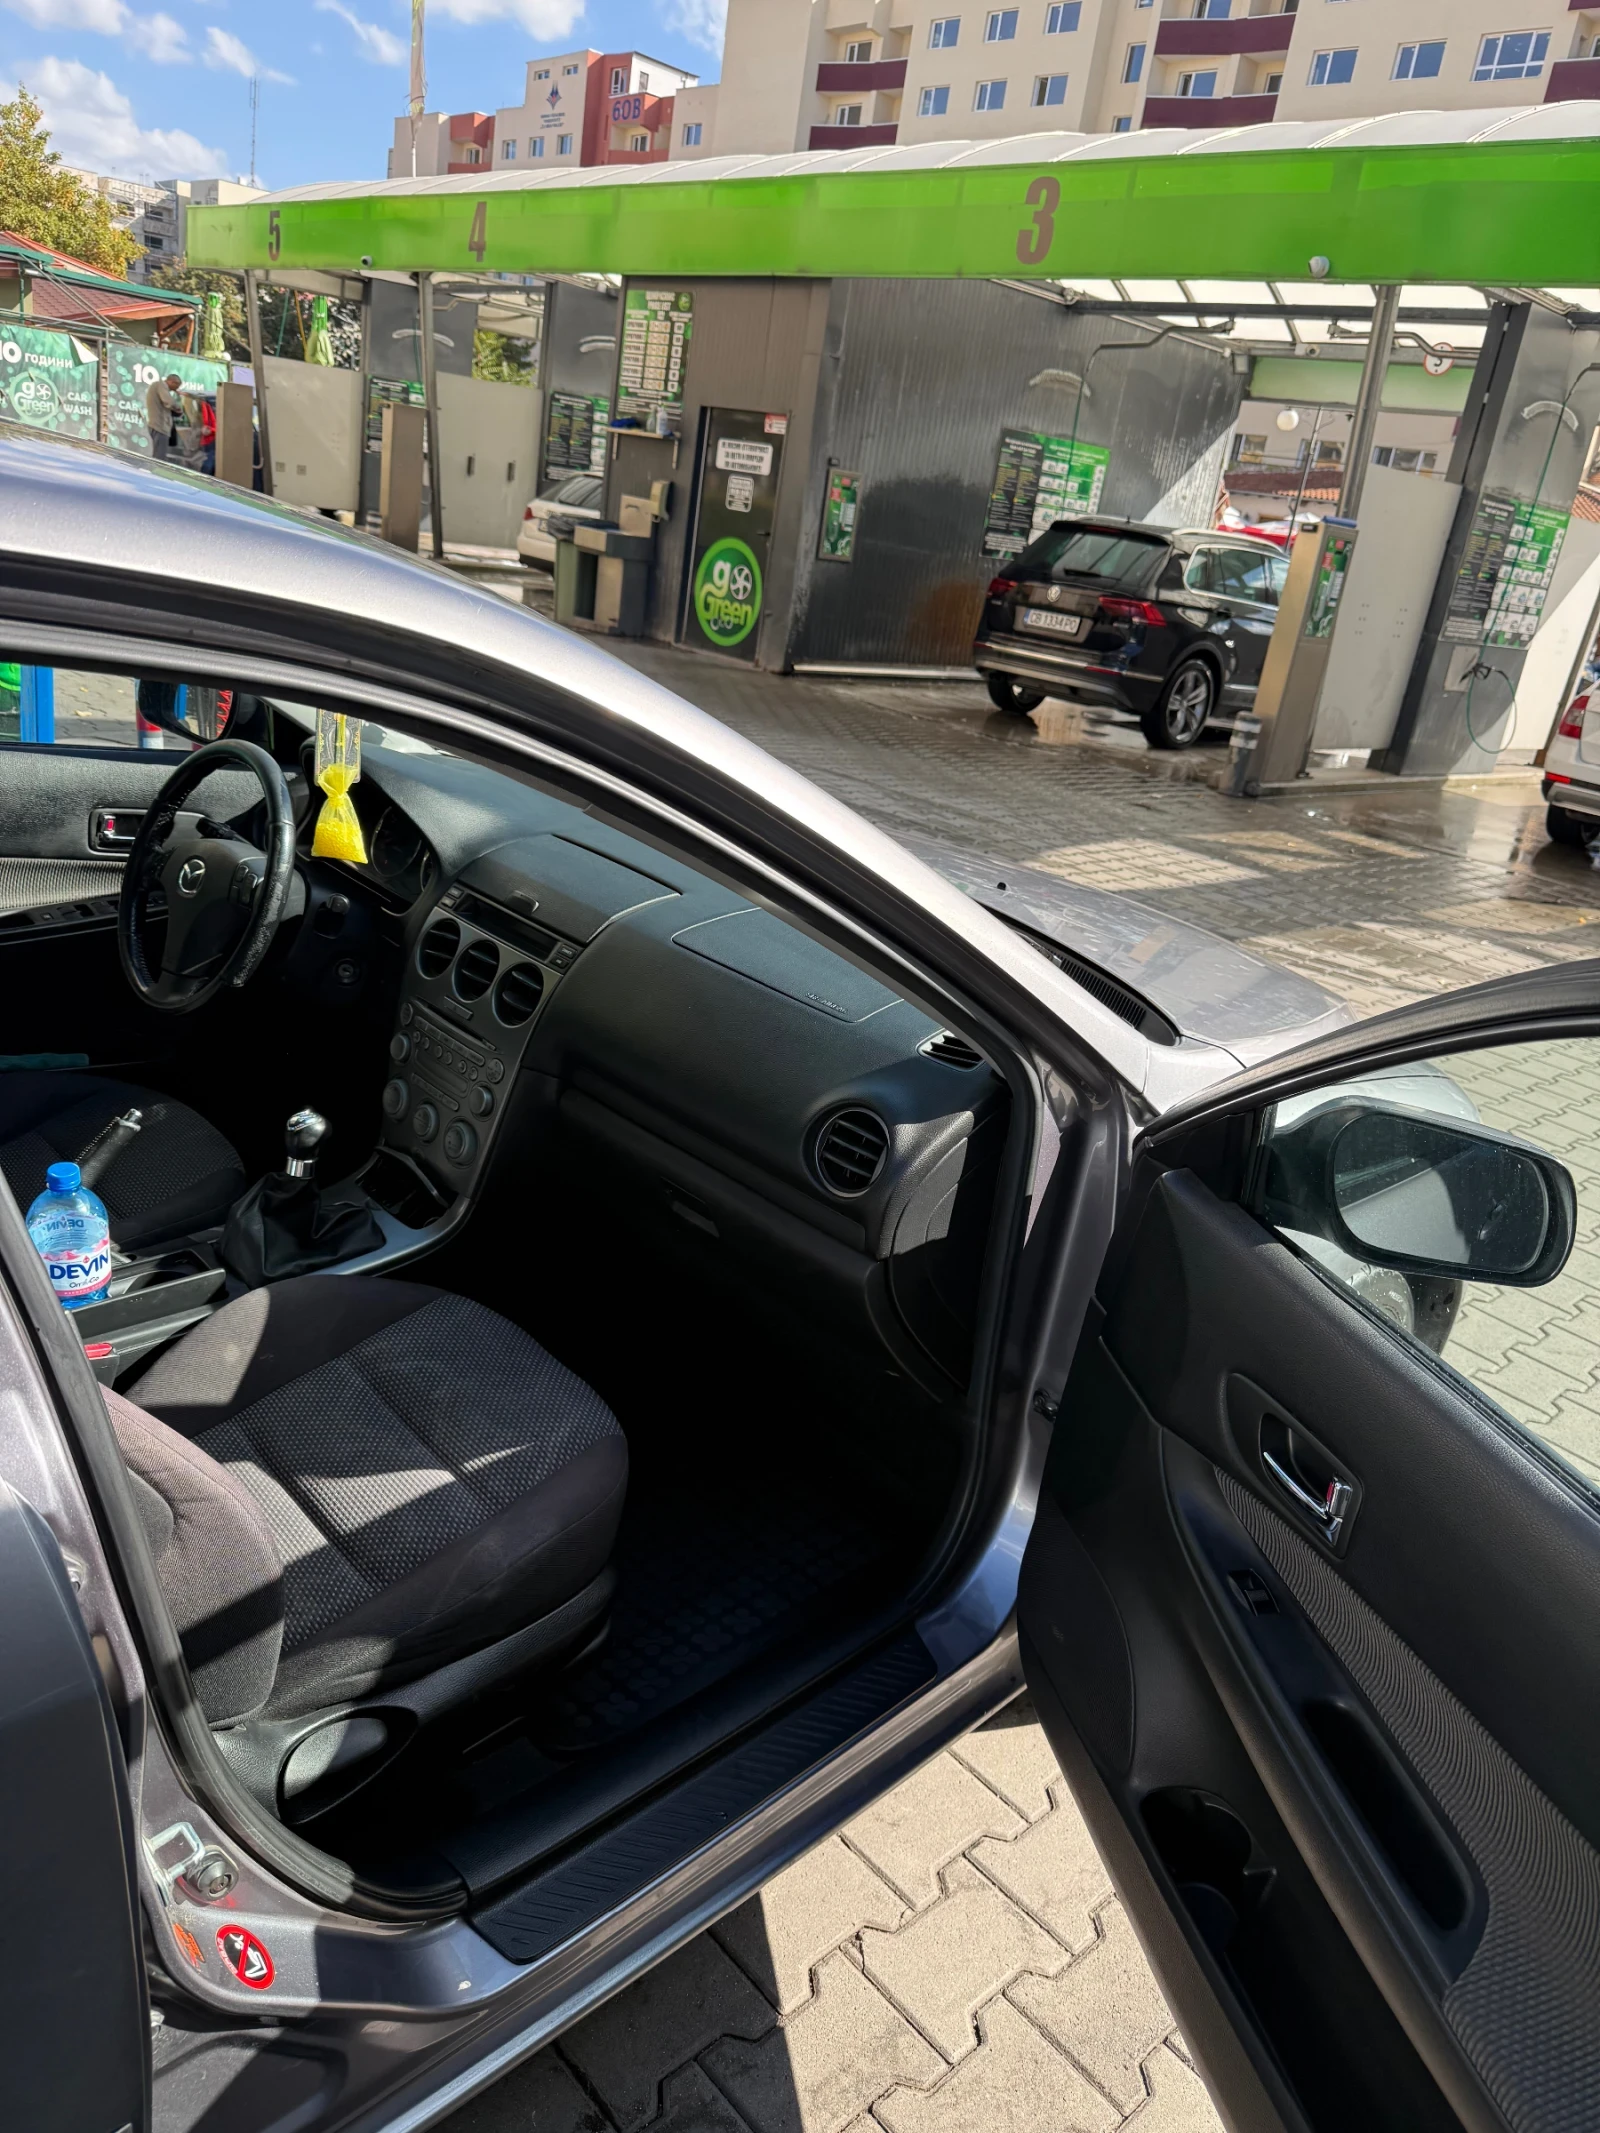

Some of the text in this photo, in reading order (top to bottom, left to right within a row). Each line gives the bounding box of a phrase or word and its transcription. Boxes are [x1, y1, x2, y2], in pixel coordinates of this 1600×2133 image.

[468, 201, 487, 262] 4
[1016, 176, 1061, 265] 3
[268, 210, 281, 261] 5
[25, 352, 73, 369] години
[133, 363, 159, 385] 10
[63, 404, 92, 415] WASH
[67, 392, 87, 402] CAR
[49, 1249, 109, 1280] DEVIN
